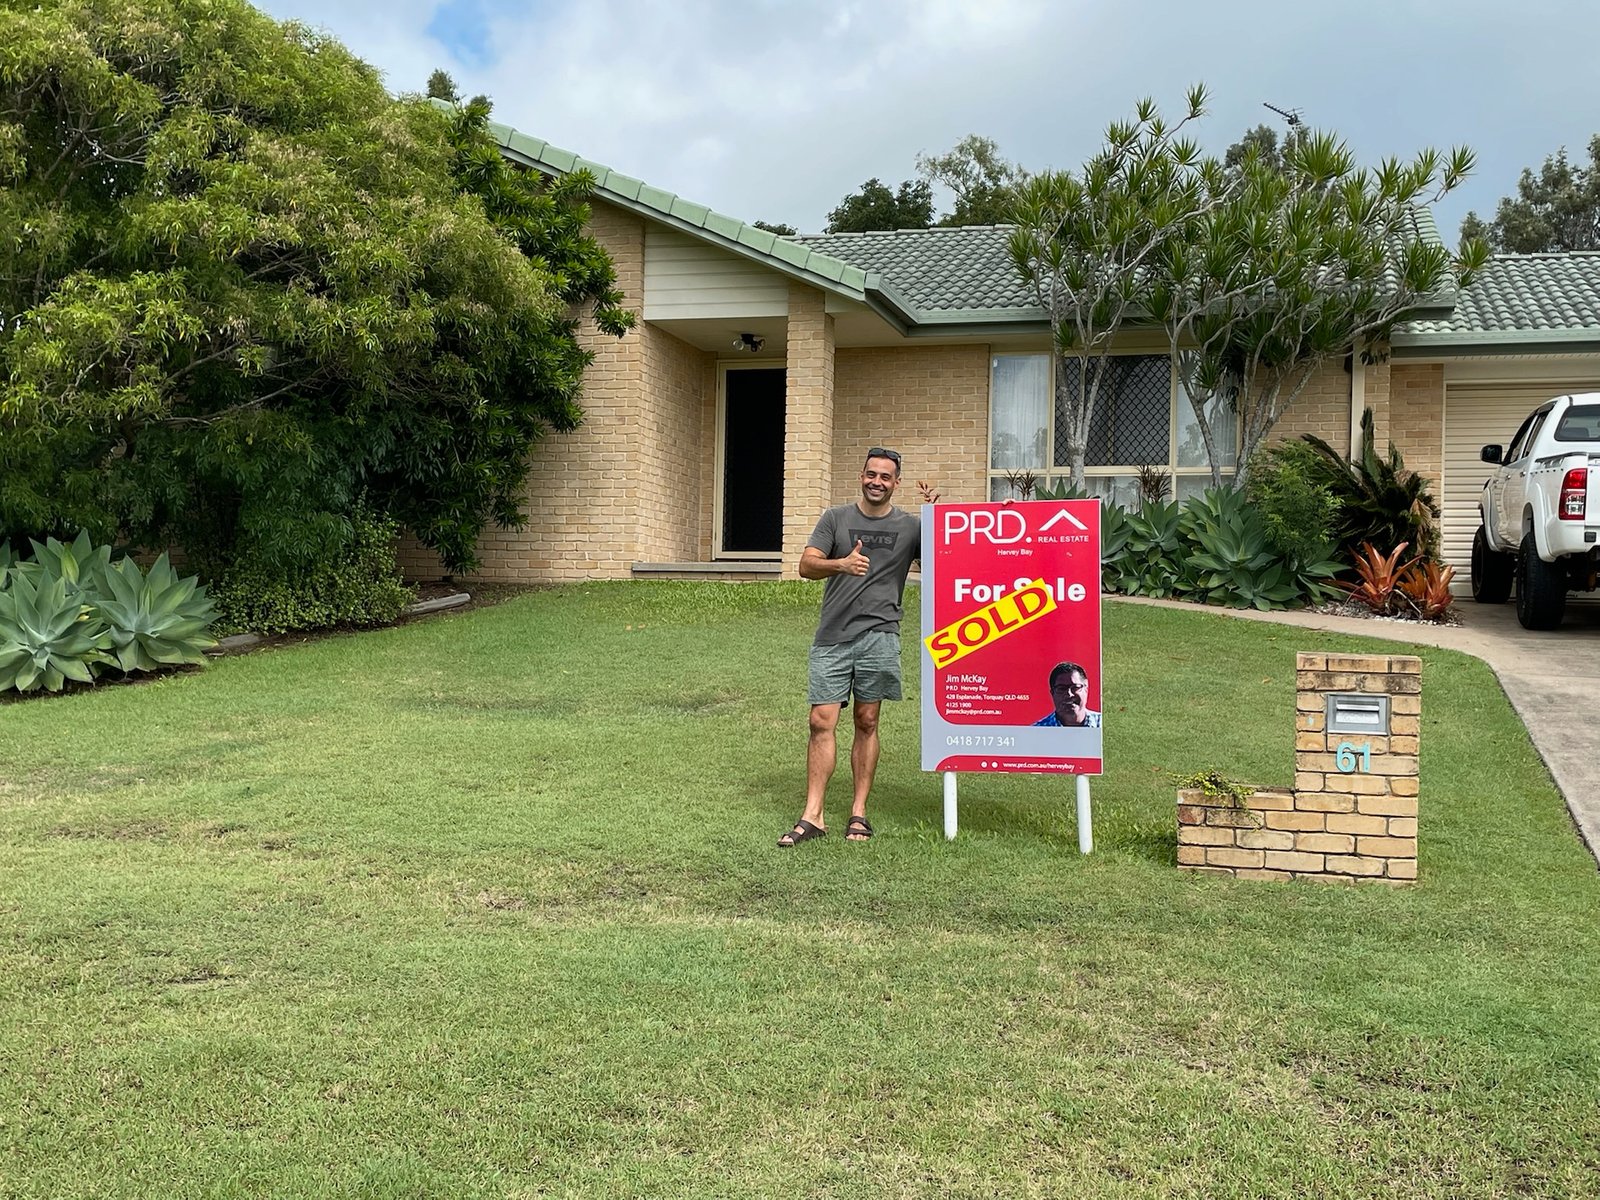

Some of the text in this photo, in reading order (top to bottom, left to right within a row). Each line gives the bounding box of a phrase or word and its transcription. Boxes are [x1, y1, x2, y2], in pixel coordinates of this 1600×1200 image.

[1060, 535, 1089, 543] ESTATE
[954, 578, 1006, 603] For
[931, 587, 1048, 663] SOLD
[946, 675, 987, 684] Jim McKay
[946, 736, 1015, 747] 0418 717 341
[1336, 742, 1370, 773] 61
